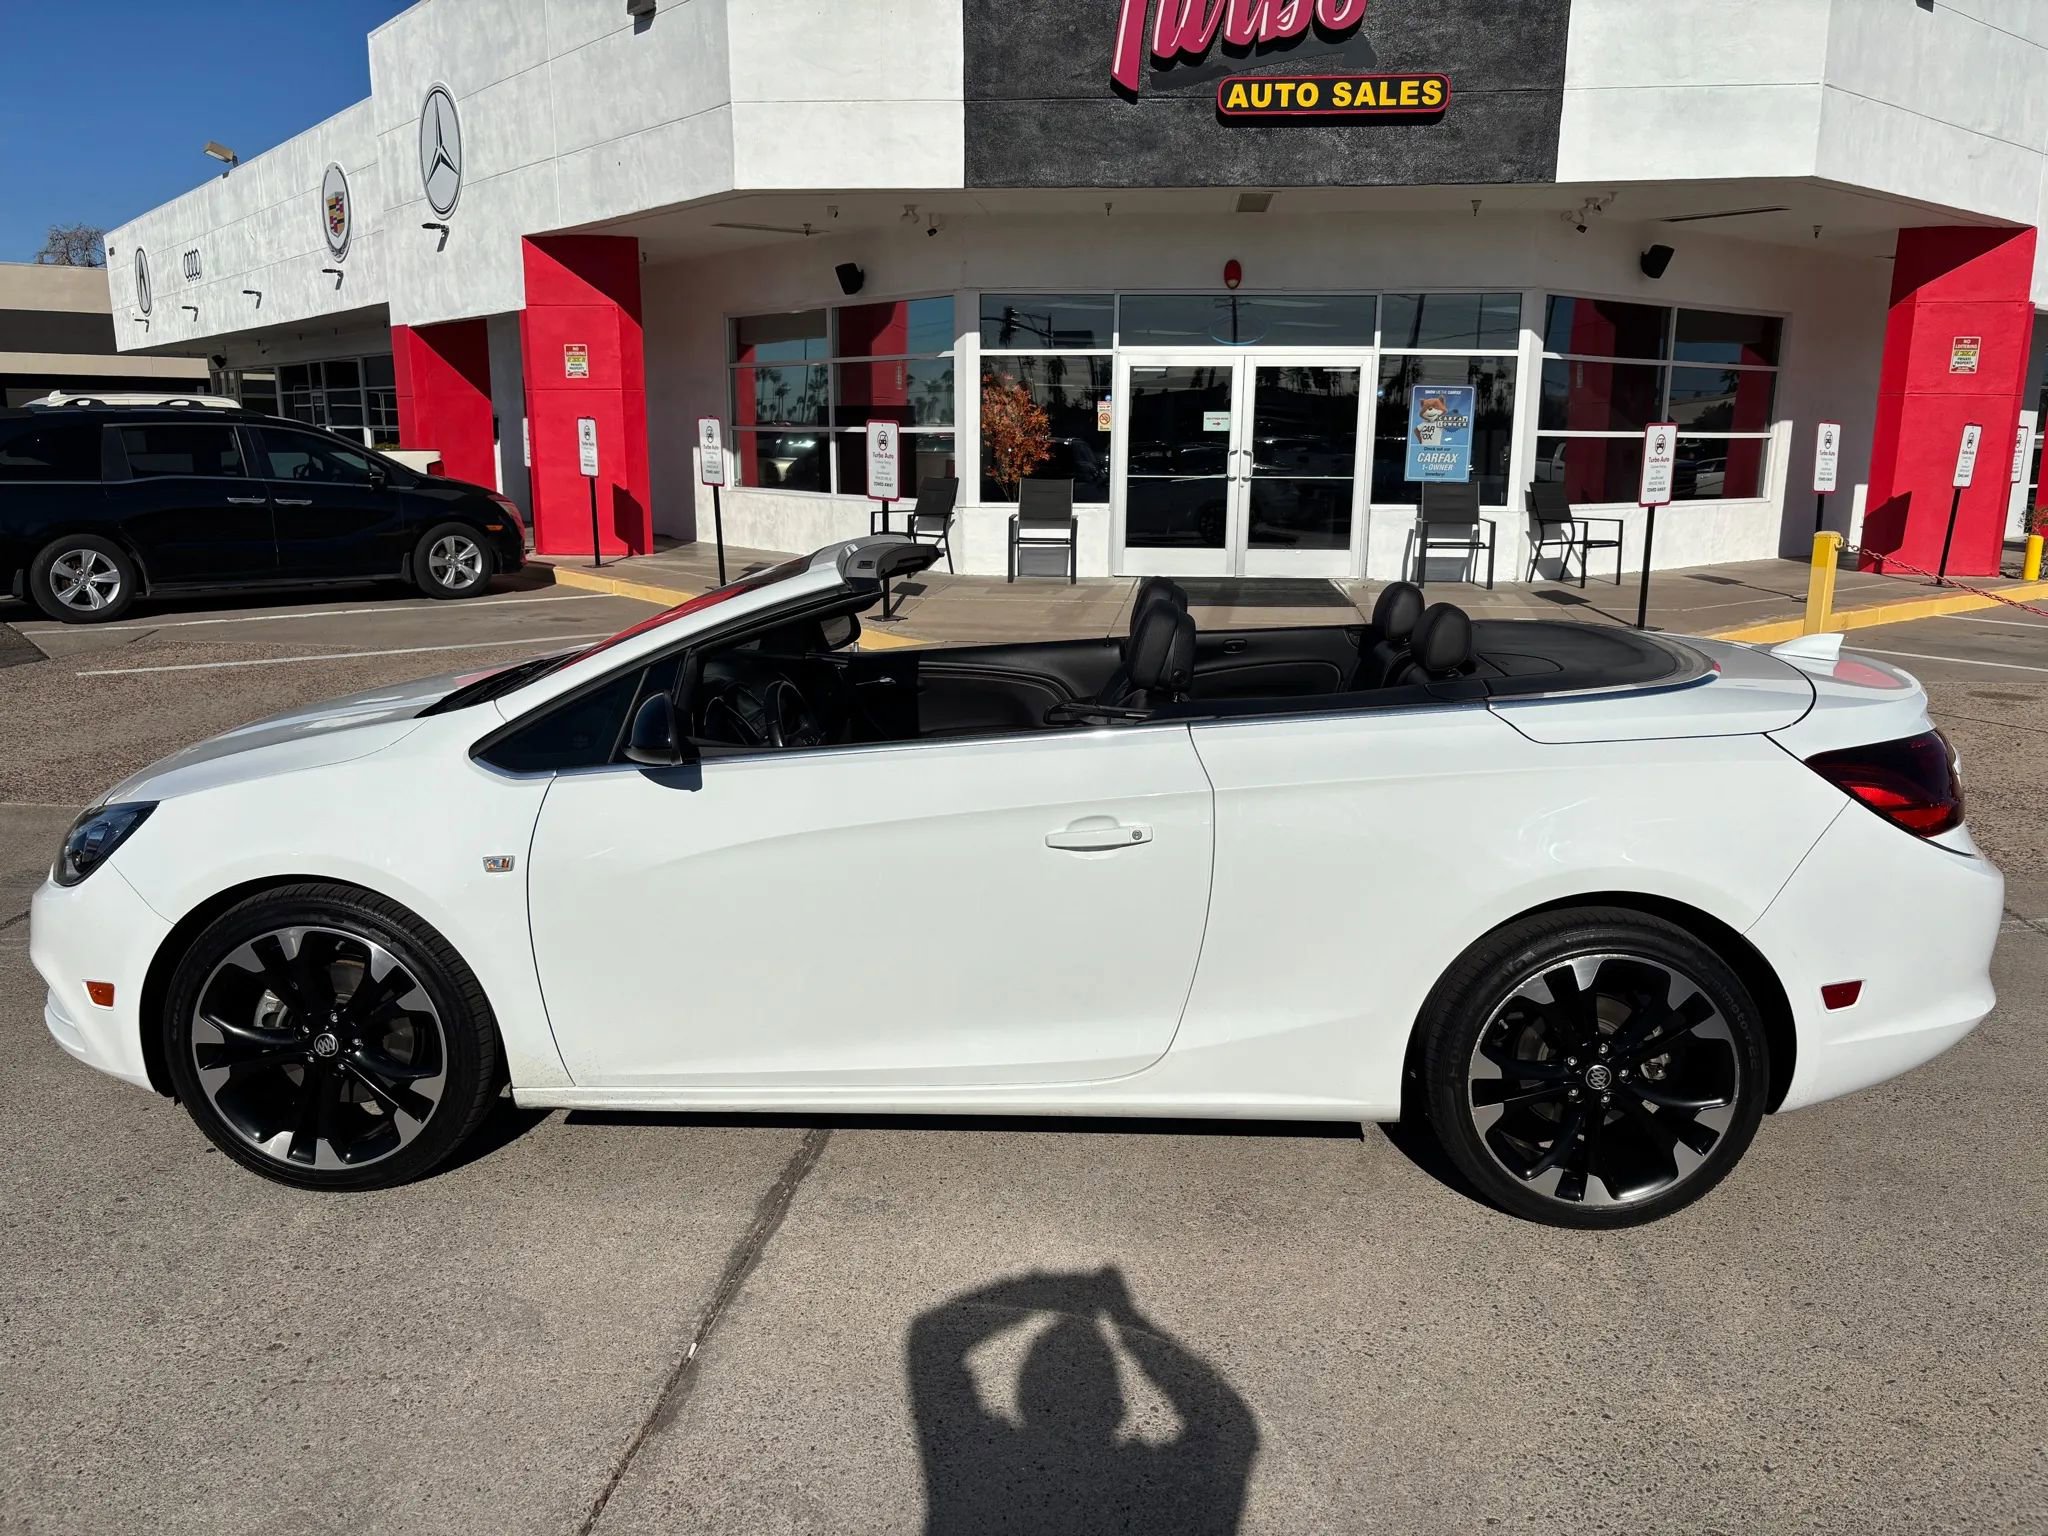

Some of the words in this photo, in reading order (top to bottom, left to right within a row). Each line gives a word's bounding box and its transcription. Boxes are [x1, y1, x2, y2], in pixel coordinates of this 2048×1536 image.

[1226, 82, 1319, 108] AUTO
[1332, 79, 1442, 107] SALES
[1417, 452, 1459, 464] CARFAX
[1422, 463, 1454, 471] 1-OWNER
